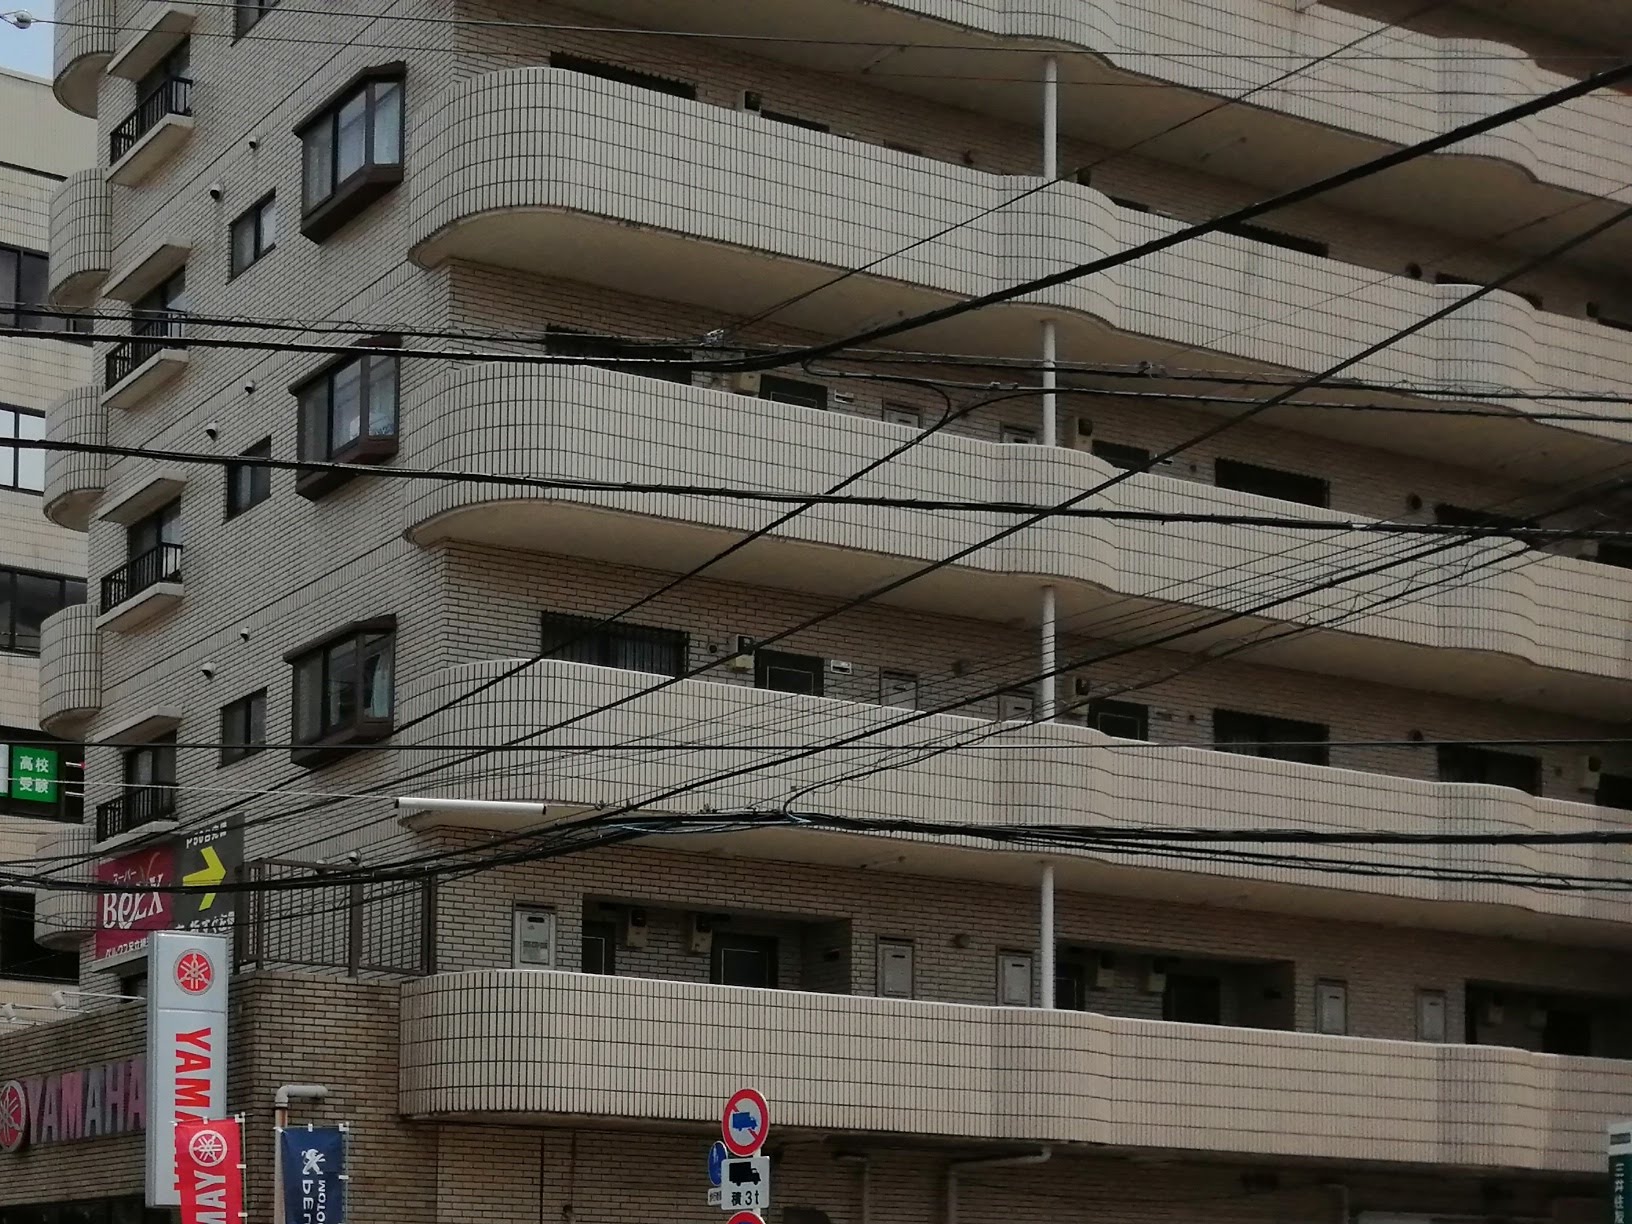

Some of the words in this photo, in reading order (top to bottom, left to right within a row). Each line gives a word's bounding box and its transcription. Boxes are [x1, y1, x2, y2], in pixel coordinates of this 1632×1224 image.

[19, 755, 49, 773] 高校
[19, 776, 49, 794] 受験
[21, 1056, 147, 1145] YAMAHA
